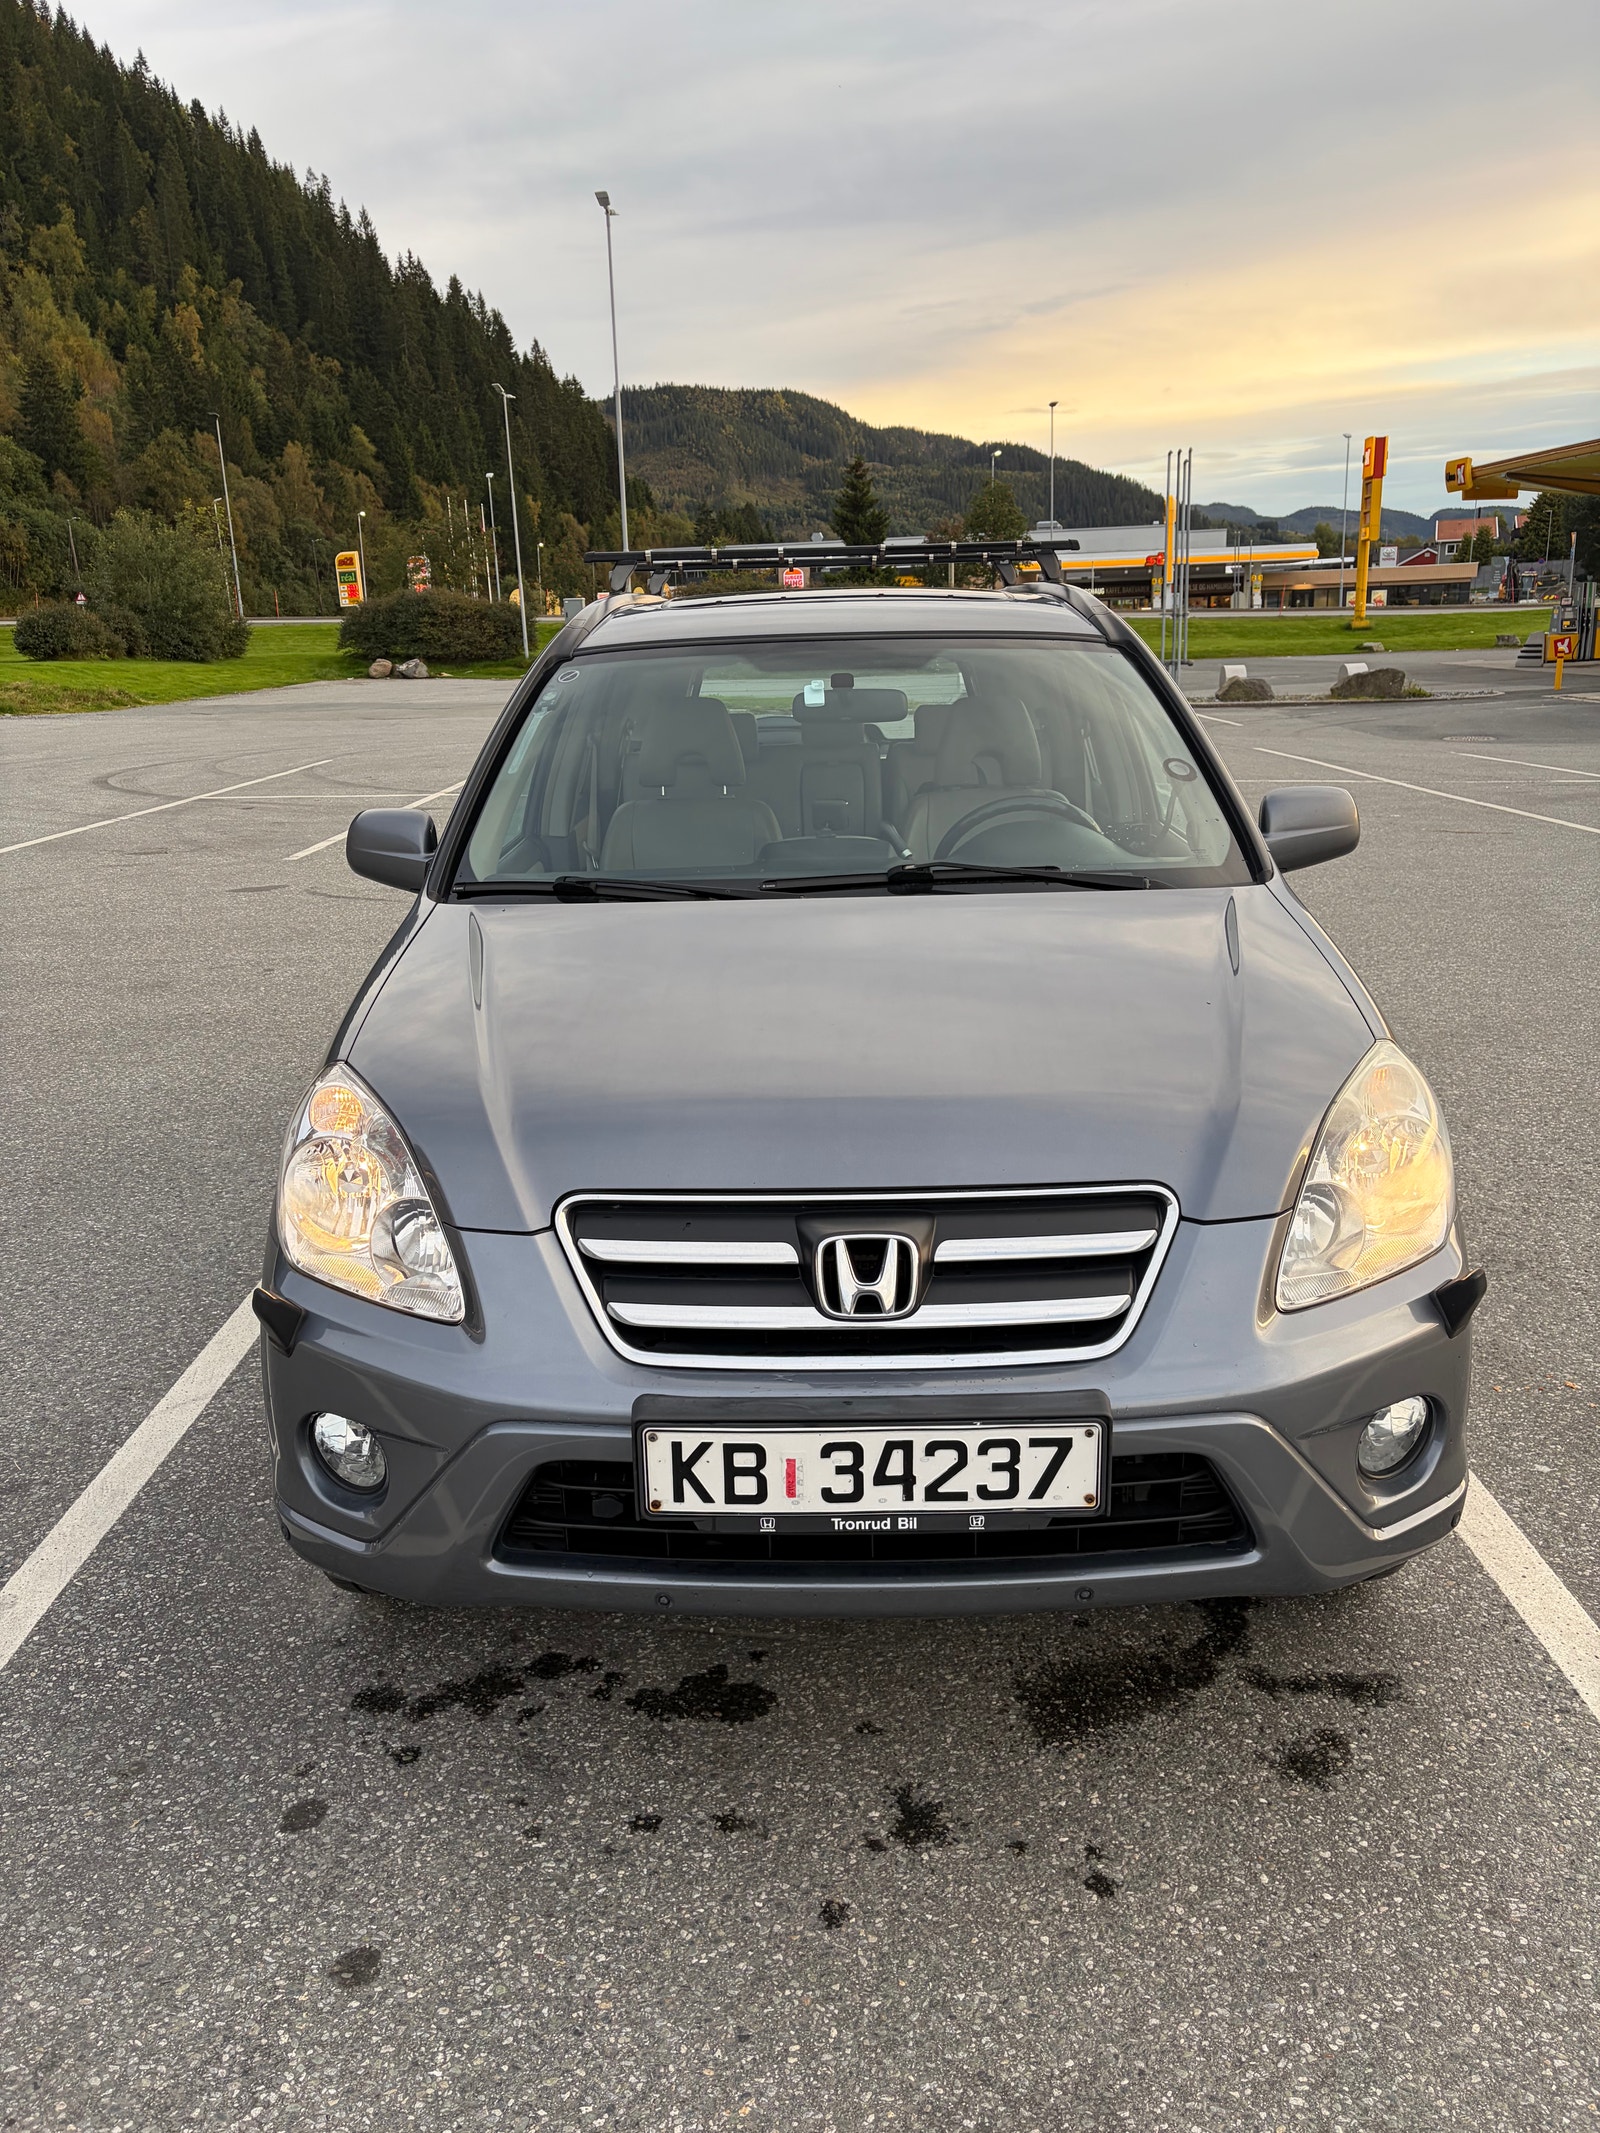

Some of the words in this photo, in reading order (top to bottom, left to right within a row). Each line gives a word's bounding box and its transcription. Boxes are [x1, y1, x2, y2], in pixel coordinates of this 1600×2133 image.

[671, 1441, 768, 1505] KB
[820, 1437, 1073, 1503] 34237
[831, 1518, 891, 1530] Tronrud
[898, 1517, 917, 1530] Bil
